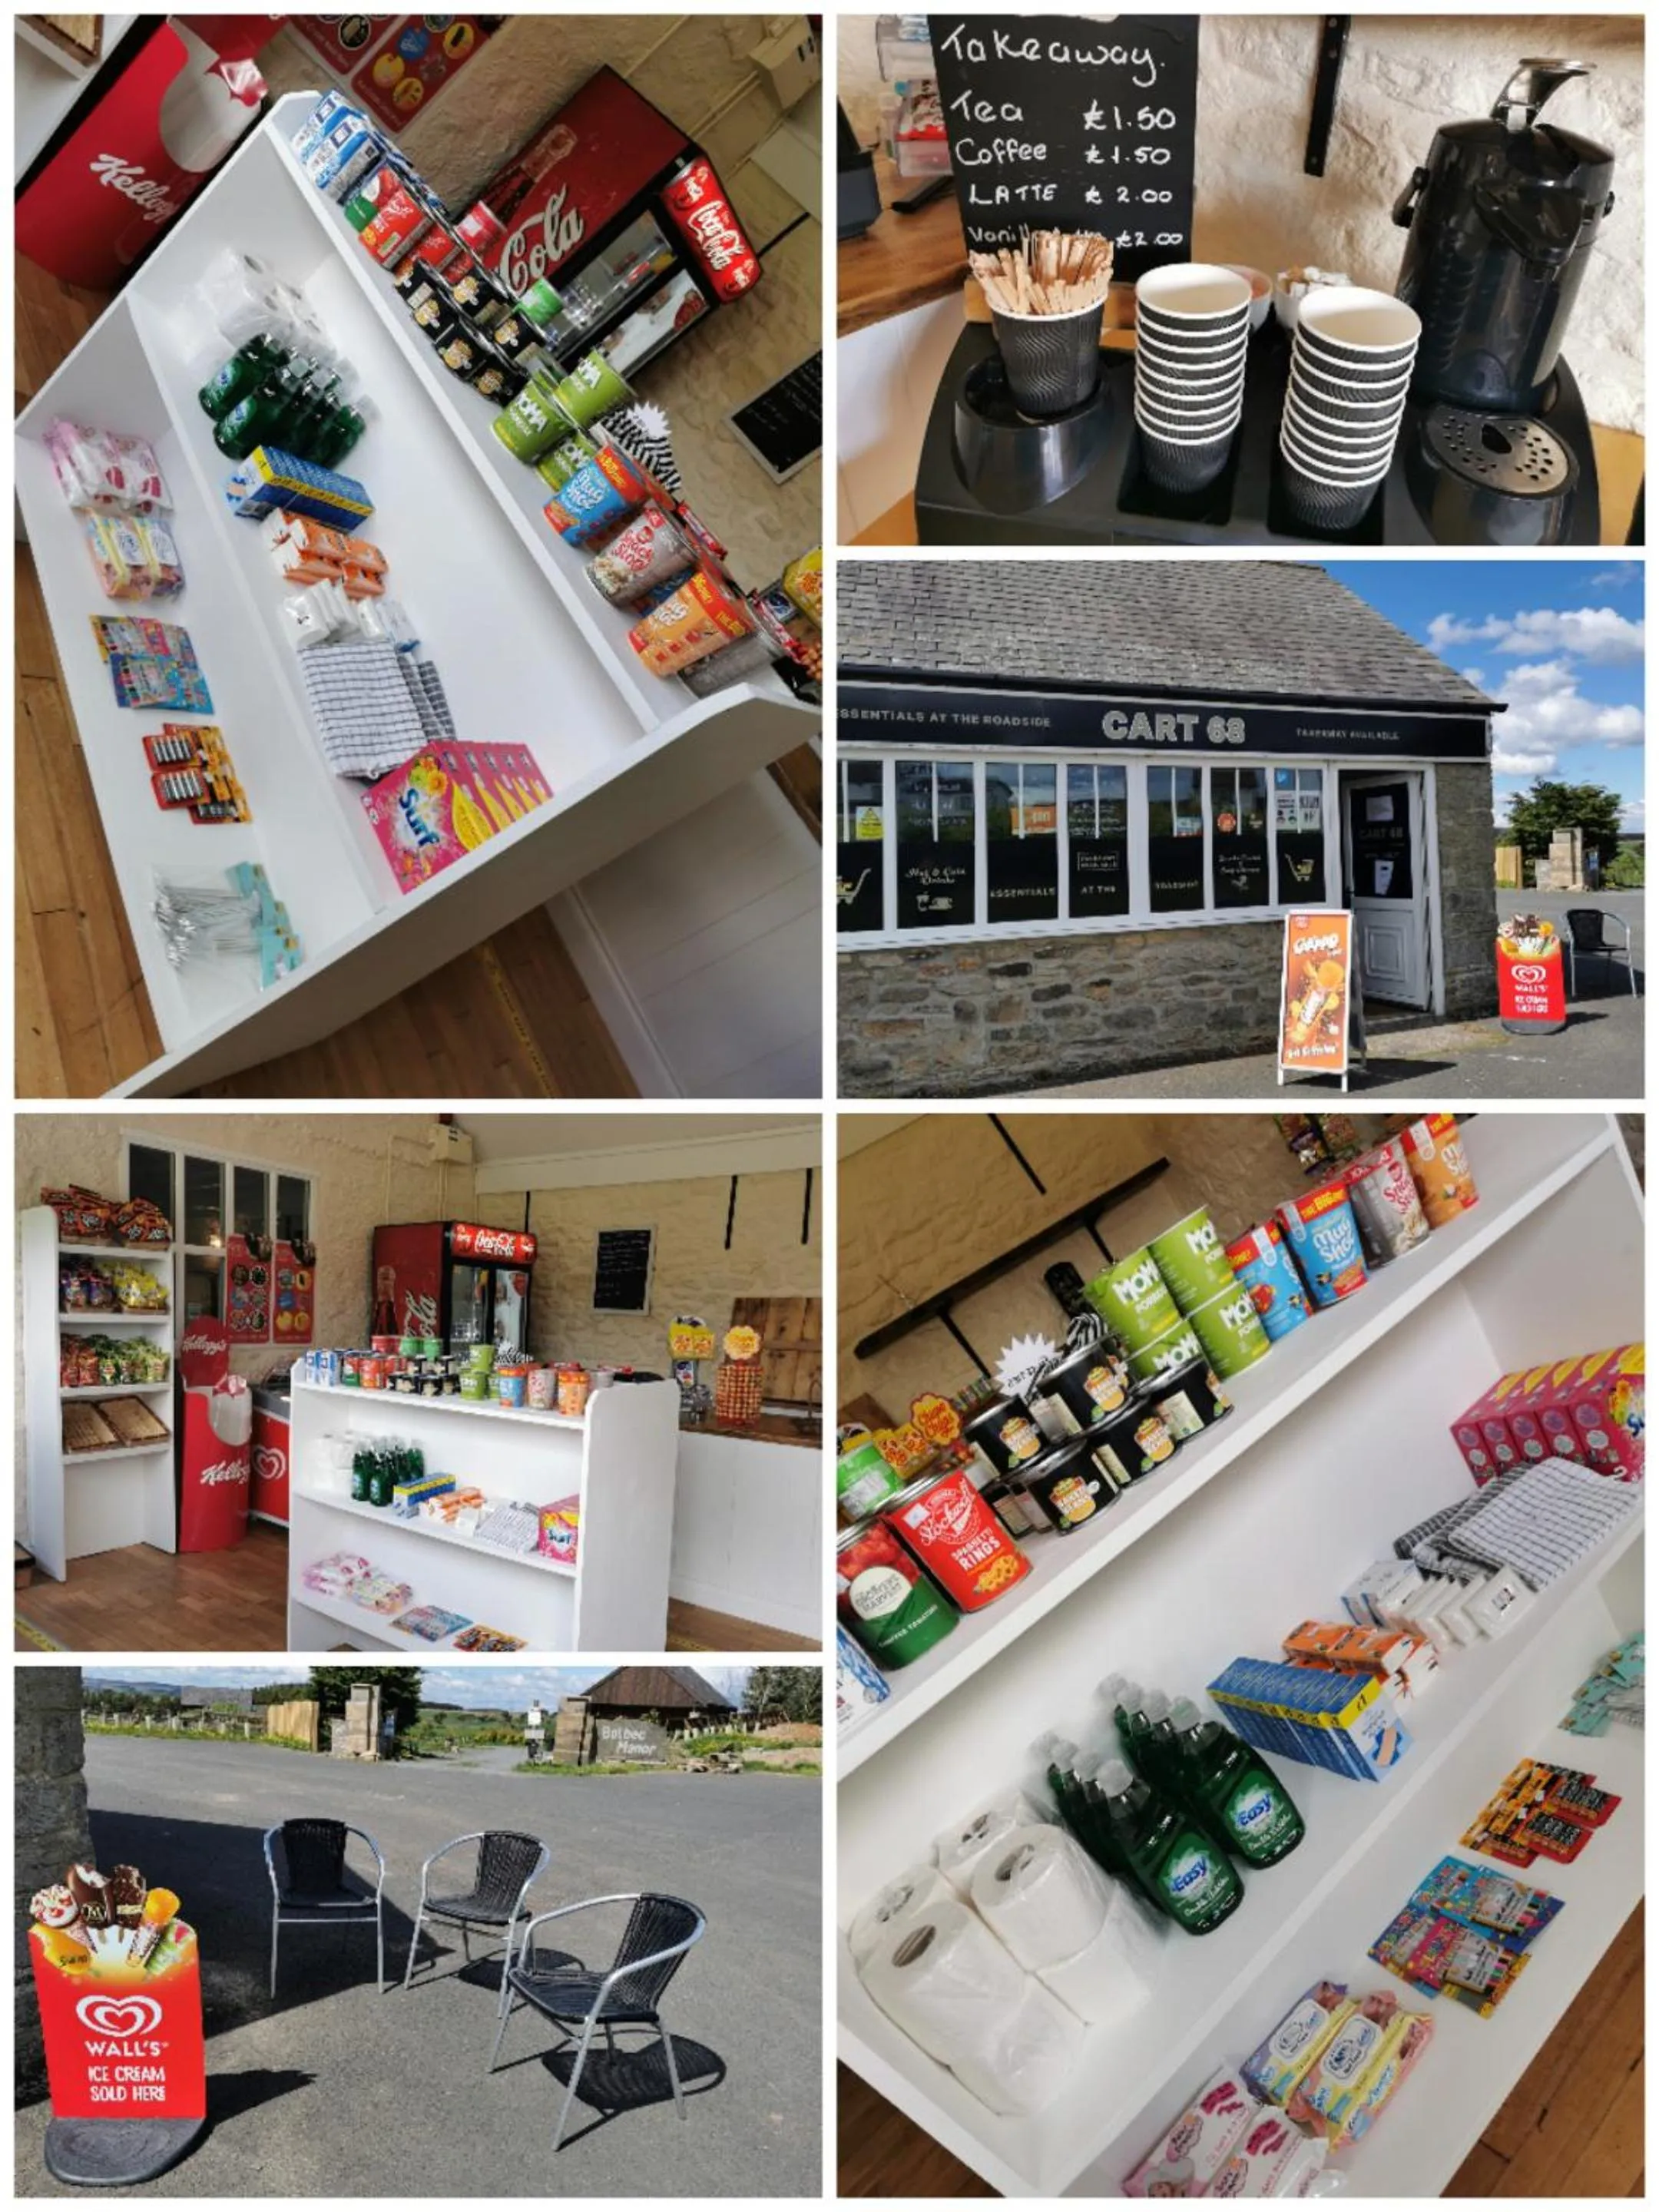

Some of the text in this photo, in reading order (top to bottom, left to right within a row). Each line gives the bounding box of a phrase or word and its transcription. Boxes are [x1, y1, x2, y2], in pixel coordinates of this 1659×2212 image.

[950, 90, 1176, 131] Tea £1.50
[955, 138, 1171, 165] Coffee £1.50
[969, 184, 1058, 204] LATTE
[929, 712, 947, 724] AT
[951, 713, 980, 725] THE
[982, 714, 1052, 727] ROADSIDE
[1101, 710, 1246, 744] CART 68
[392, 785, 445, 851] Surf
[989, 886, 1056, 898] ESSENTIALS
[957, 1535, 1002, 1571] RINGS
[615, 1740, 658, 1757] Manor
[1235, 1793, 1273, 1826] Easy
[1168, 1855, 1207, 1893] Easy
[84, 2040, 163, 2058] WALL'S
[88, 2065, 167, 2082] ICE CREAM
[90, 2085, 167, 2102] SOLD HERE
